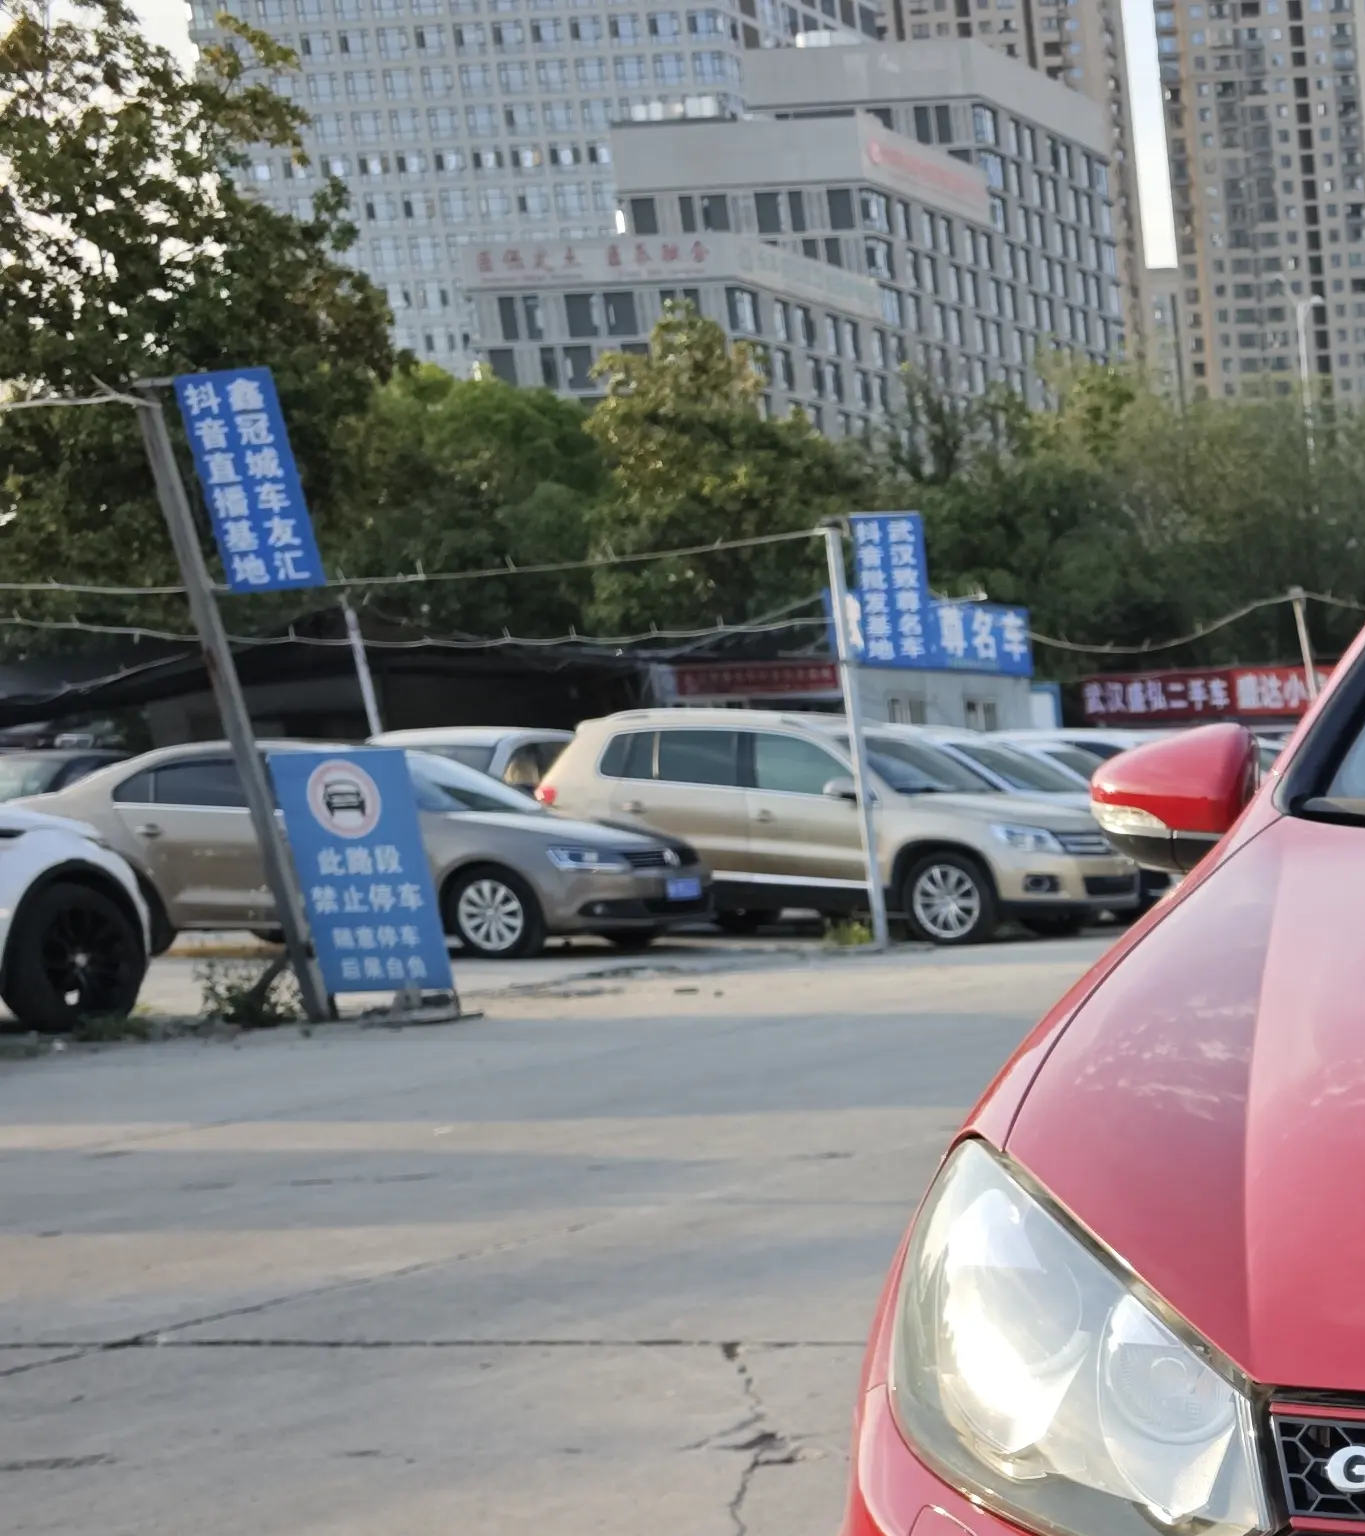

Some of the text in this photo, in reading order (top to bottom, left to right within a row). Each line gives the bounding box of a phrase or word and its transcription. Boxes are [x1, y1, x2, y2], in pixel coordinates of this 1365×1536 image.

[184, 381, 271, 584] 抖音直播基地
[317, 844, 403, 876] 此路段
[310, 882, 425, 915] 禁止停车
